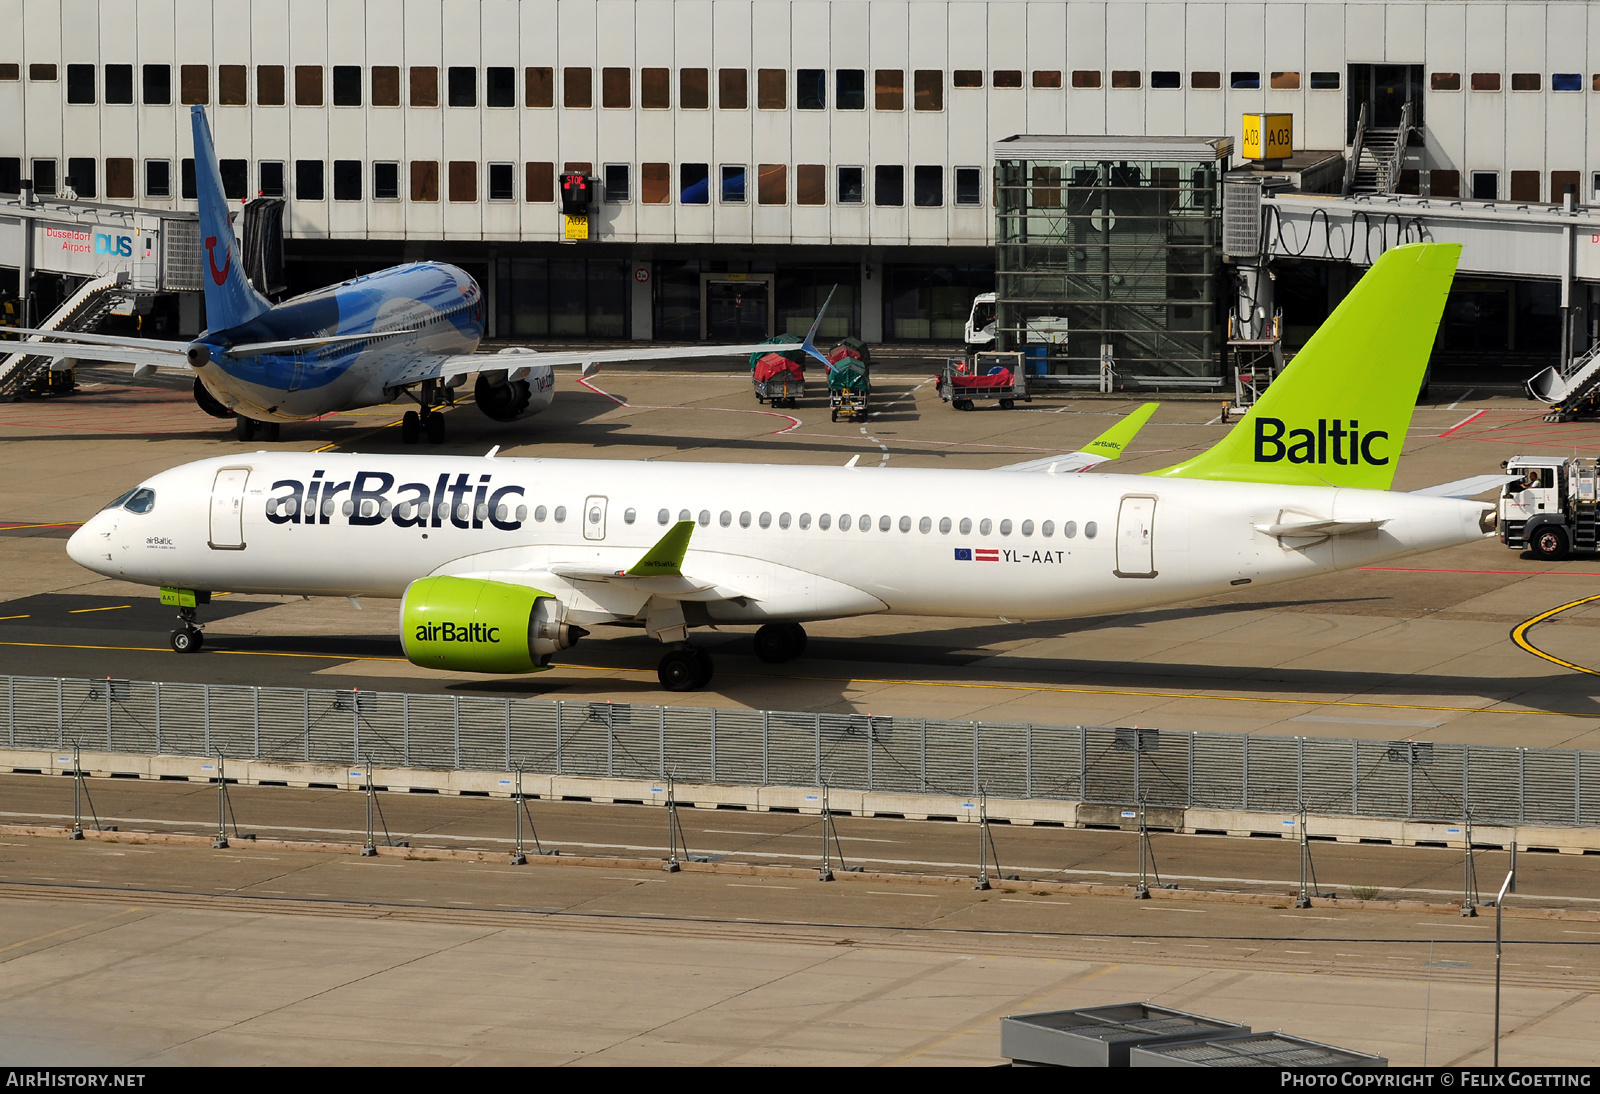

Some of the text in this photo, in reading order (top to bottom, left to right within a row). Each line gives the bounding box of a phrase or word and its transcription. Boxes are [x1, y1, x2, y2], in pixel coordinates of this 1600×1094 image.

[1244, 129, 1259, 145] A 03
[1268, 129, 1290, 146] A 03
[566, 175, 584, 185] STOP
[567, 216, 587, 226] A02
[46, 227, 92, 241] Düsseldorf
[61, 241, 91, 253] Airport
[95, 233, 132, 257] DUS
[1092, 440, 1121, 450] airBaltic
[1254, 417, 1389, 466] Baltic
[265, 470, 526, 531] airBaltic
[146, 536, 173, 545] airBaltic
[1002, 549, 1064, 564] YL-AAT
[644, 560, 678, 568] airBaltic
[415, 621, 501, 643] airBaltic
